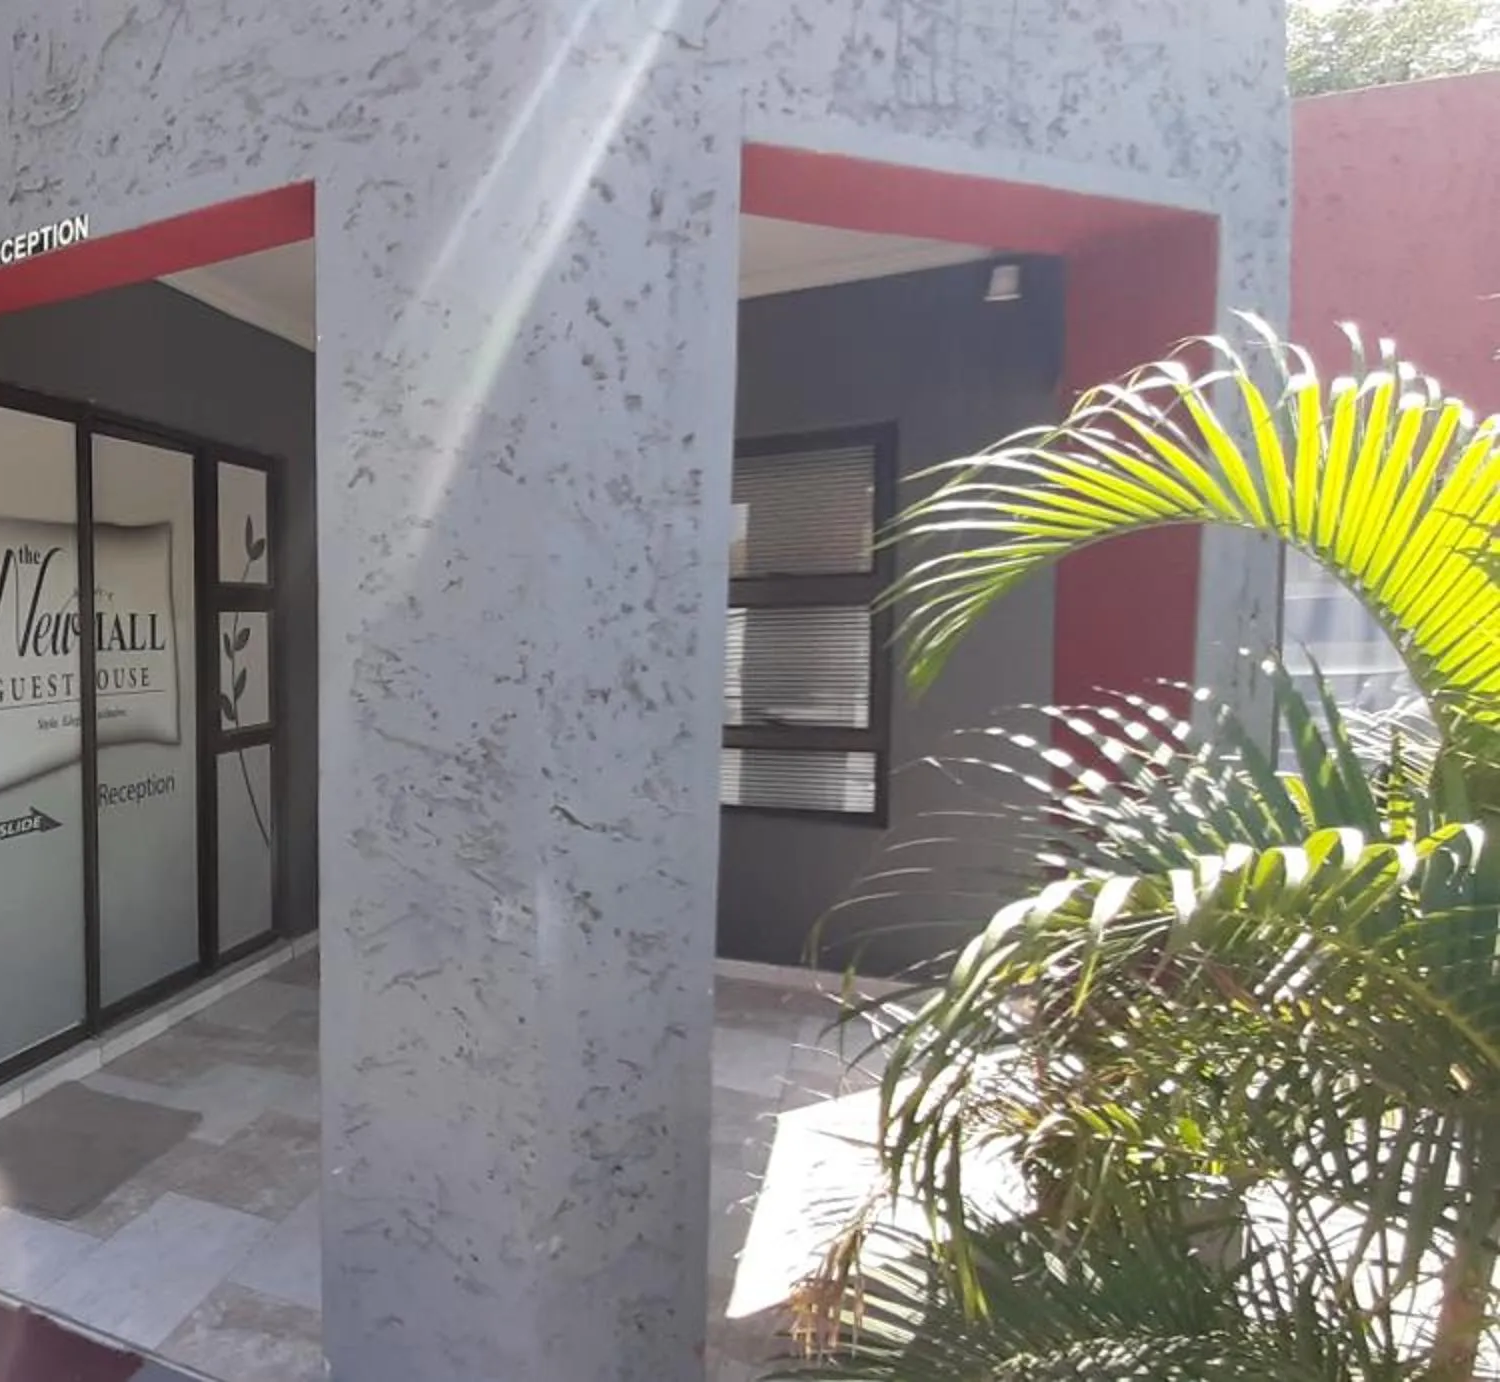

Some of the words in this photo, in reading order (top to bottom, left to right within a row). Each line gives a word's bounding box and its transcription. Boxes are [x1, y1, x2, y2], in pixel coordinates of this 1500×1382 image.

[19, 545, 41, 564] the
[97, 667, 150, 690] OUSE
[99, 774, 175, 806] Reception
[0, 815, 43, 837] SLIDE
